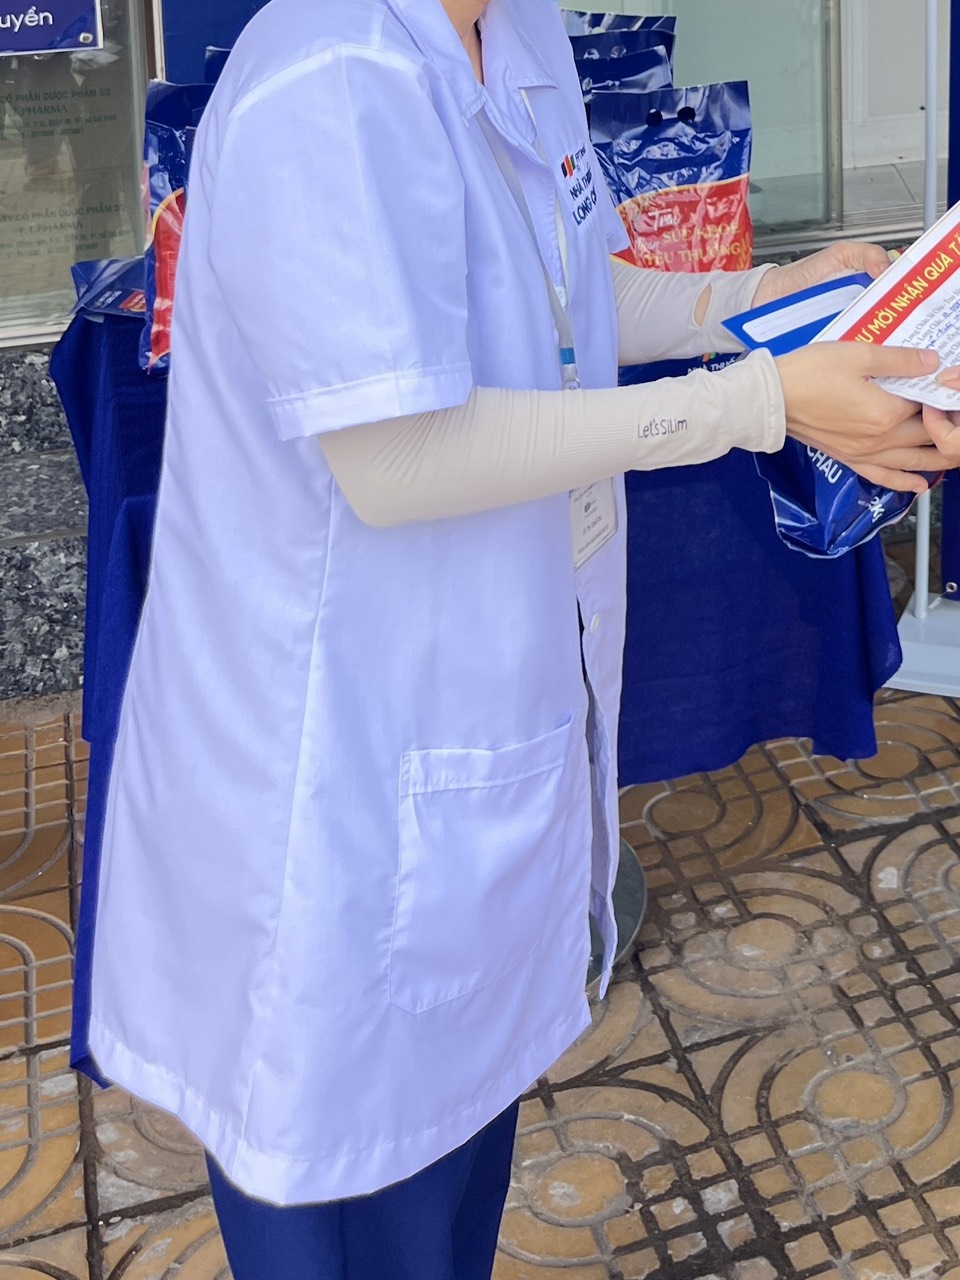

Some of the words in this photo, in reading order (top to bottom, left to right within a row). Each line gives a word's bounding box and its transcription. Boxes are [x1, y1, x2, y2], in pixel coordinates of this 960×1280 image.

[572, 196, 592, 226] LONG
[867, 307, 898, 335] MỜI
[890, 276, 929, 313] NHẬN
[923, 250, 954, 280] QUÀ
